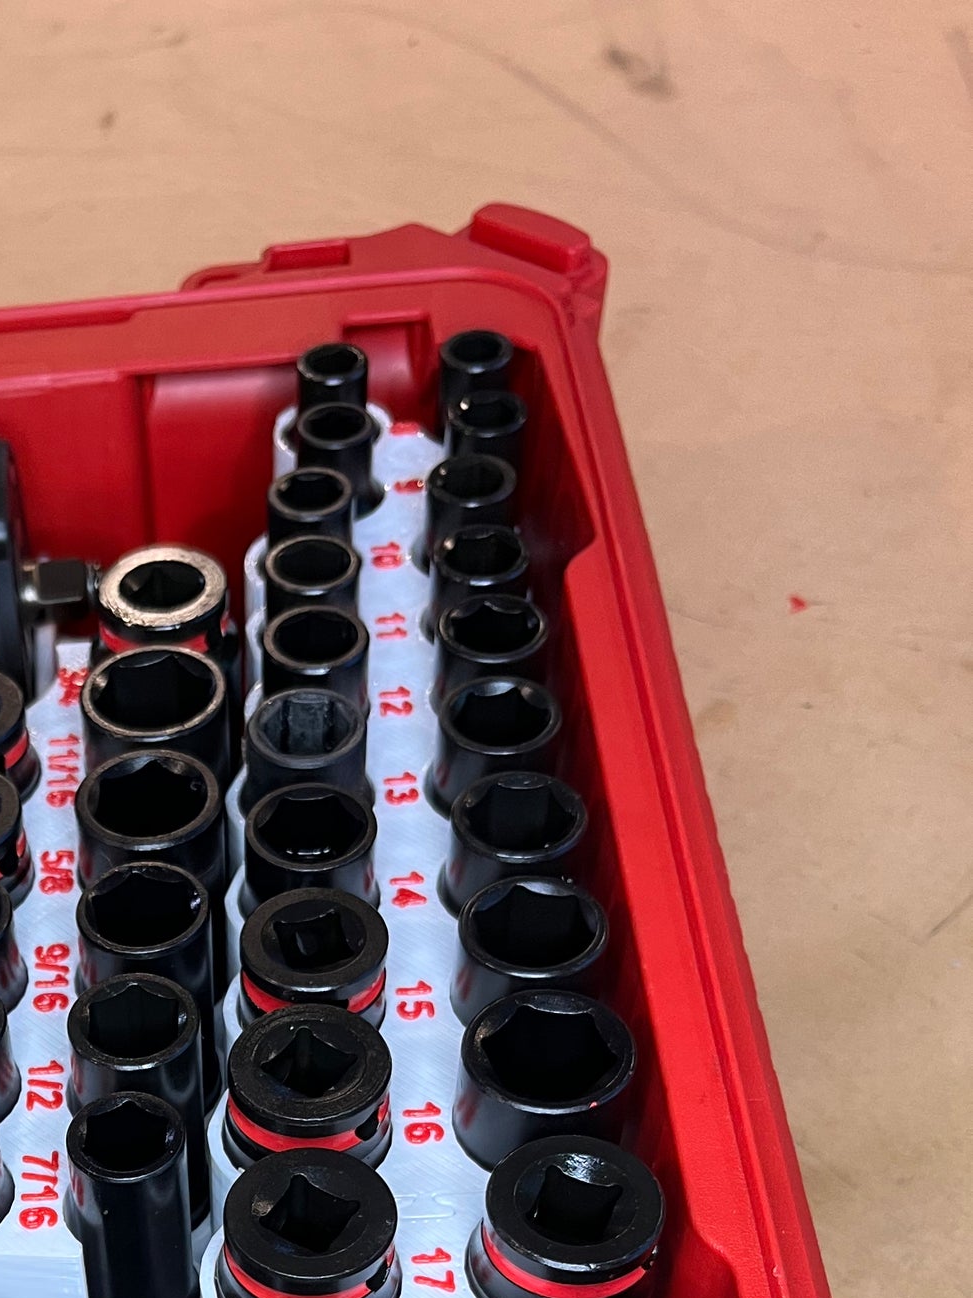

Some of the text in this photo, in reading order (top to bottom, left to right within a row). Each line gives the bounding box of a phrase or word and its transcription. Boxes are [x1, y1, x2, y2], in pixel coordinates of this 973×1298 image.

[370, 541, 403, 570] 10
[375, 611, 406, 640] 11
[379, 685, 413, 717] 12
[45, 733, 81, 808] 11/16
[383, 770, 420, 806] 13
[39, 850, 75, 895] 5/8
[389, 869, 428, 909] 14
[32, 942, 71, 1013] 9/16
[395, 979, 436, 1021] 15
[26, 1059, 65, 1111] 1/2
[402, 1101, 445, 1146] 16
[18, 1150, 60, 1230] 7/16
[410, 1246, 456, 1294] 17
